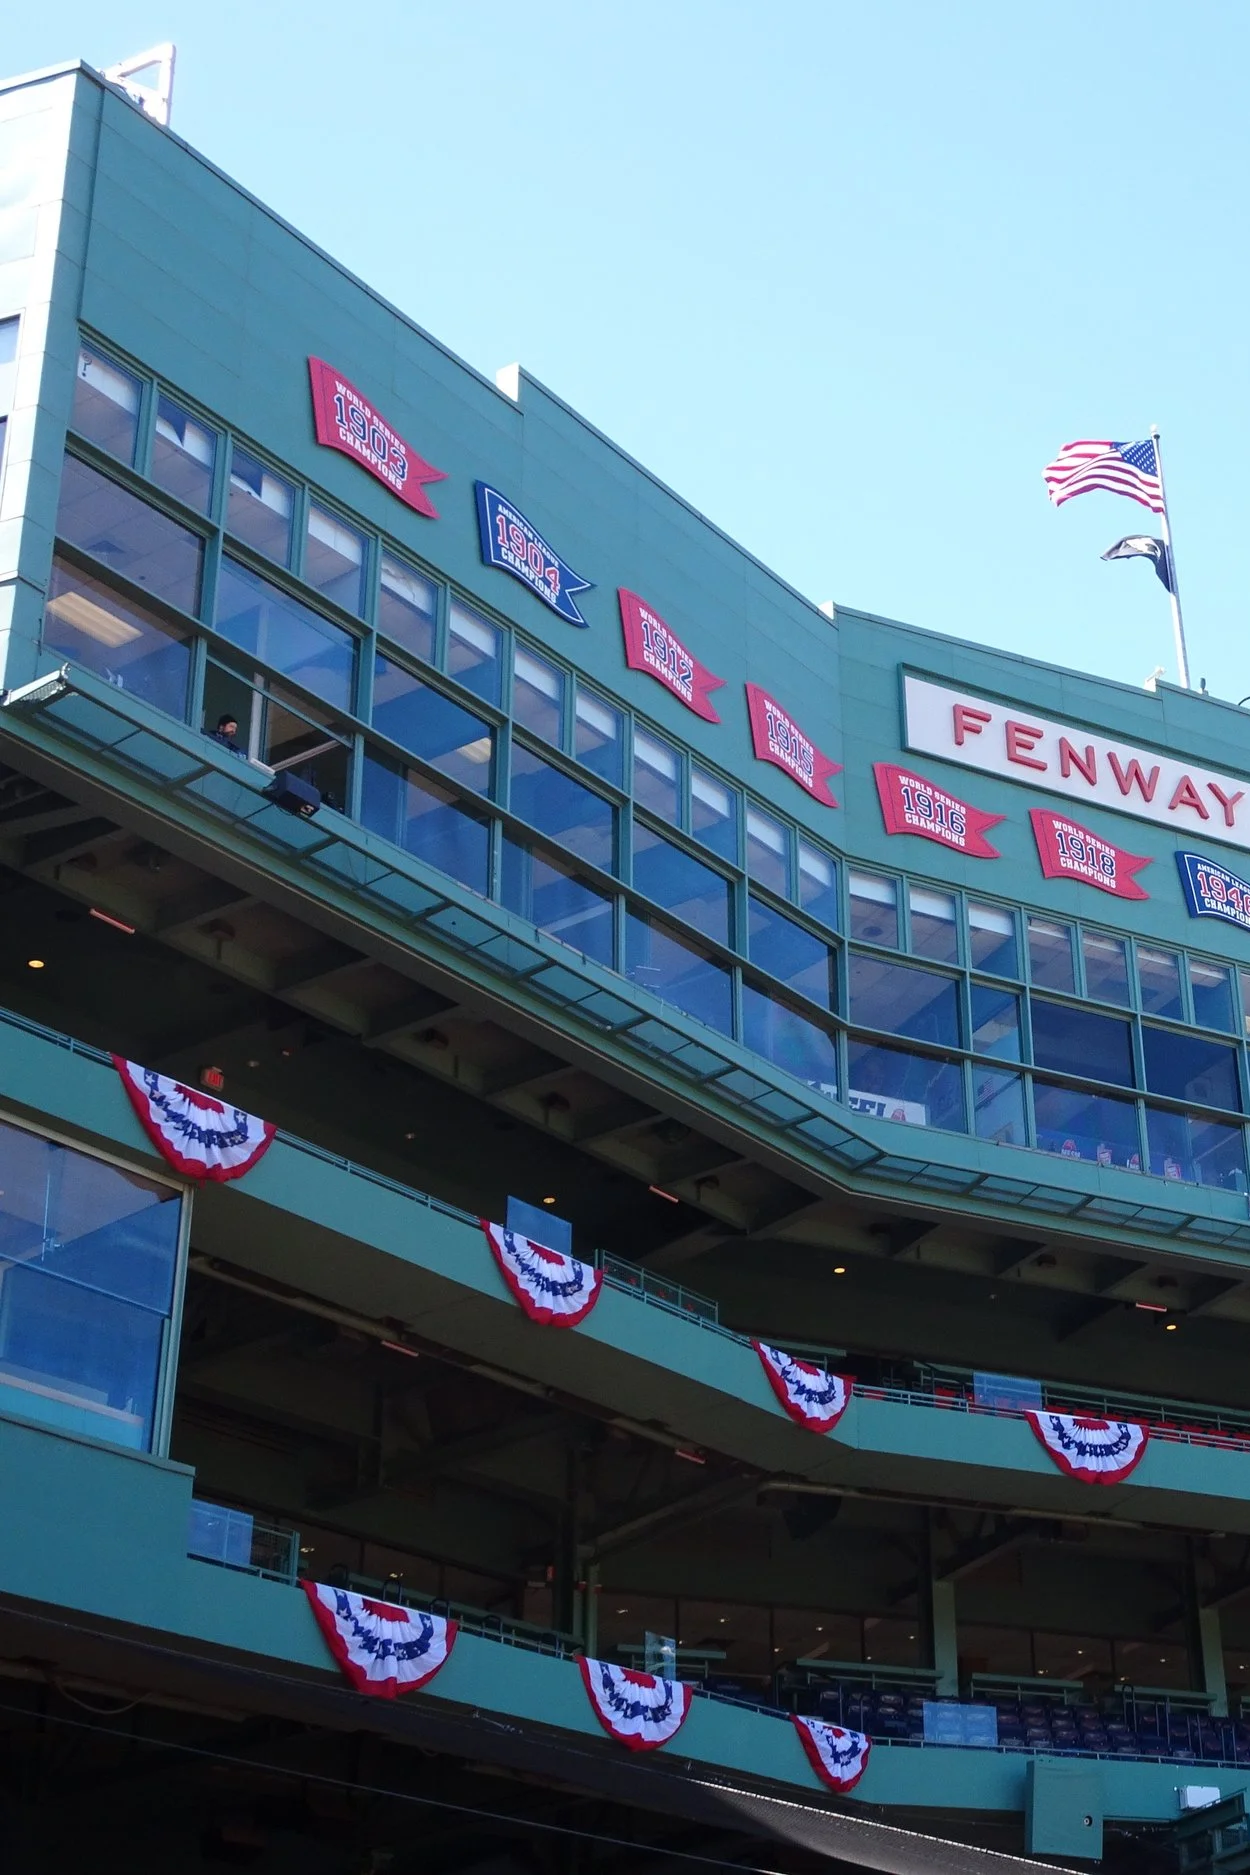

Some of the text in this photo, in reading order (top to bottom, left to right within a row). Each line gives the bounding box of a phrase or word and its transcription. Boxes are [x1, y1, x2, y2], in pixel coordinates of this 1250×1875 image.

[334, 395, 408, 481] 1903
[335, 381, 406, 454] WORLD SERIES
[338, 426, 403, 490] CHAMPIONS
[497, 514, 561, 593] 1904
[498, 504, 559, 567] AMERICAN LEAGUE
[501, 548, 558, 604] CHAMPIONS
[639, 607, 693, 667] WORLD SERIES
[641, 621, 693, 691] 1912
[643, 649, 693, 702] CHAMPIONS
[764, 700, 813, 754] WORLD SERIES
[766, 712, 814, 777] 1915
[768, 740, 813, 788] CHAMPIONS
[953, 703, 1245, 826] FENWAY
[898, 776, 966, 814] WORLD SERIES
[901, 787, 966, 837] 1916
[905, 813, 965, 847] CHAMPIONS
[1052, 820, 1115, 857] WORLD SERIES
[1055, 831, 1116, 878] 1918
[1060, 856, 1116, 889] CHAMPIONS
[1197, 863, 1230, 884] AMERICAN
